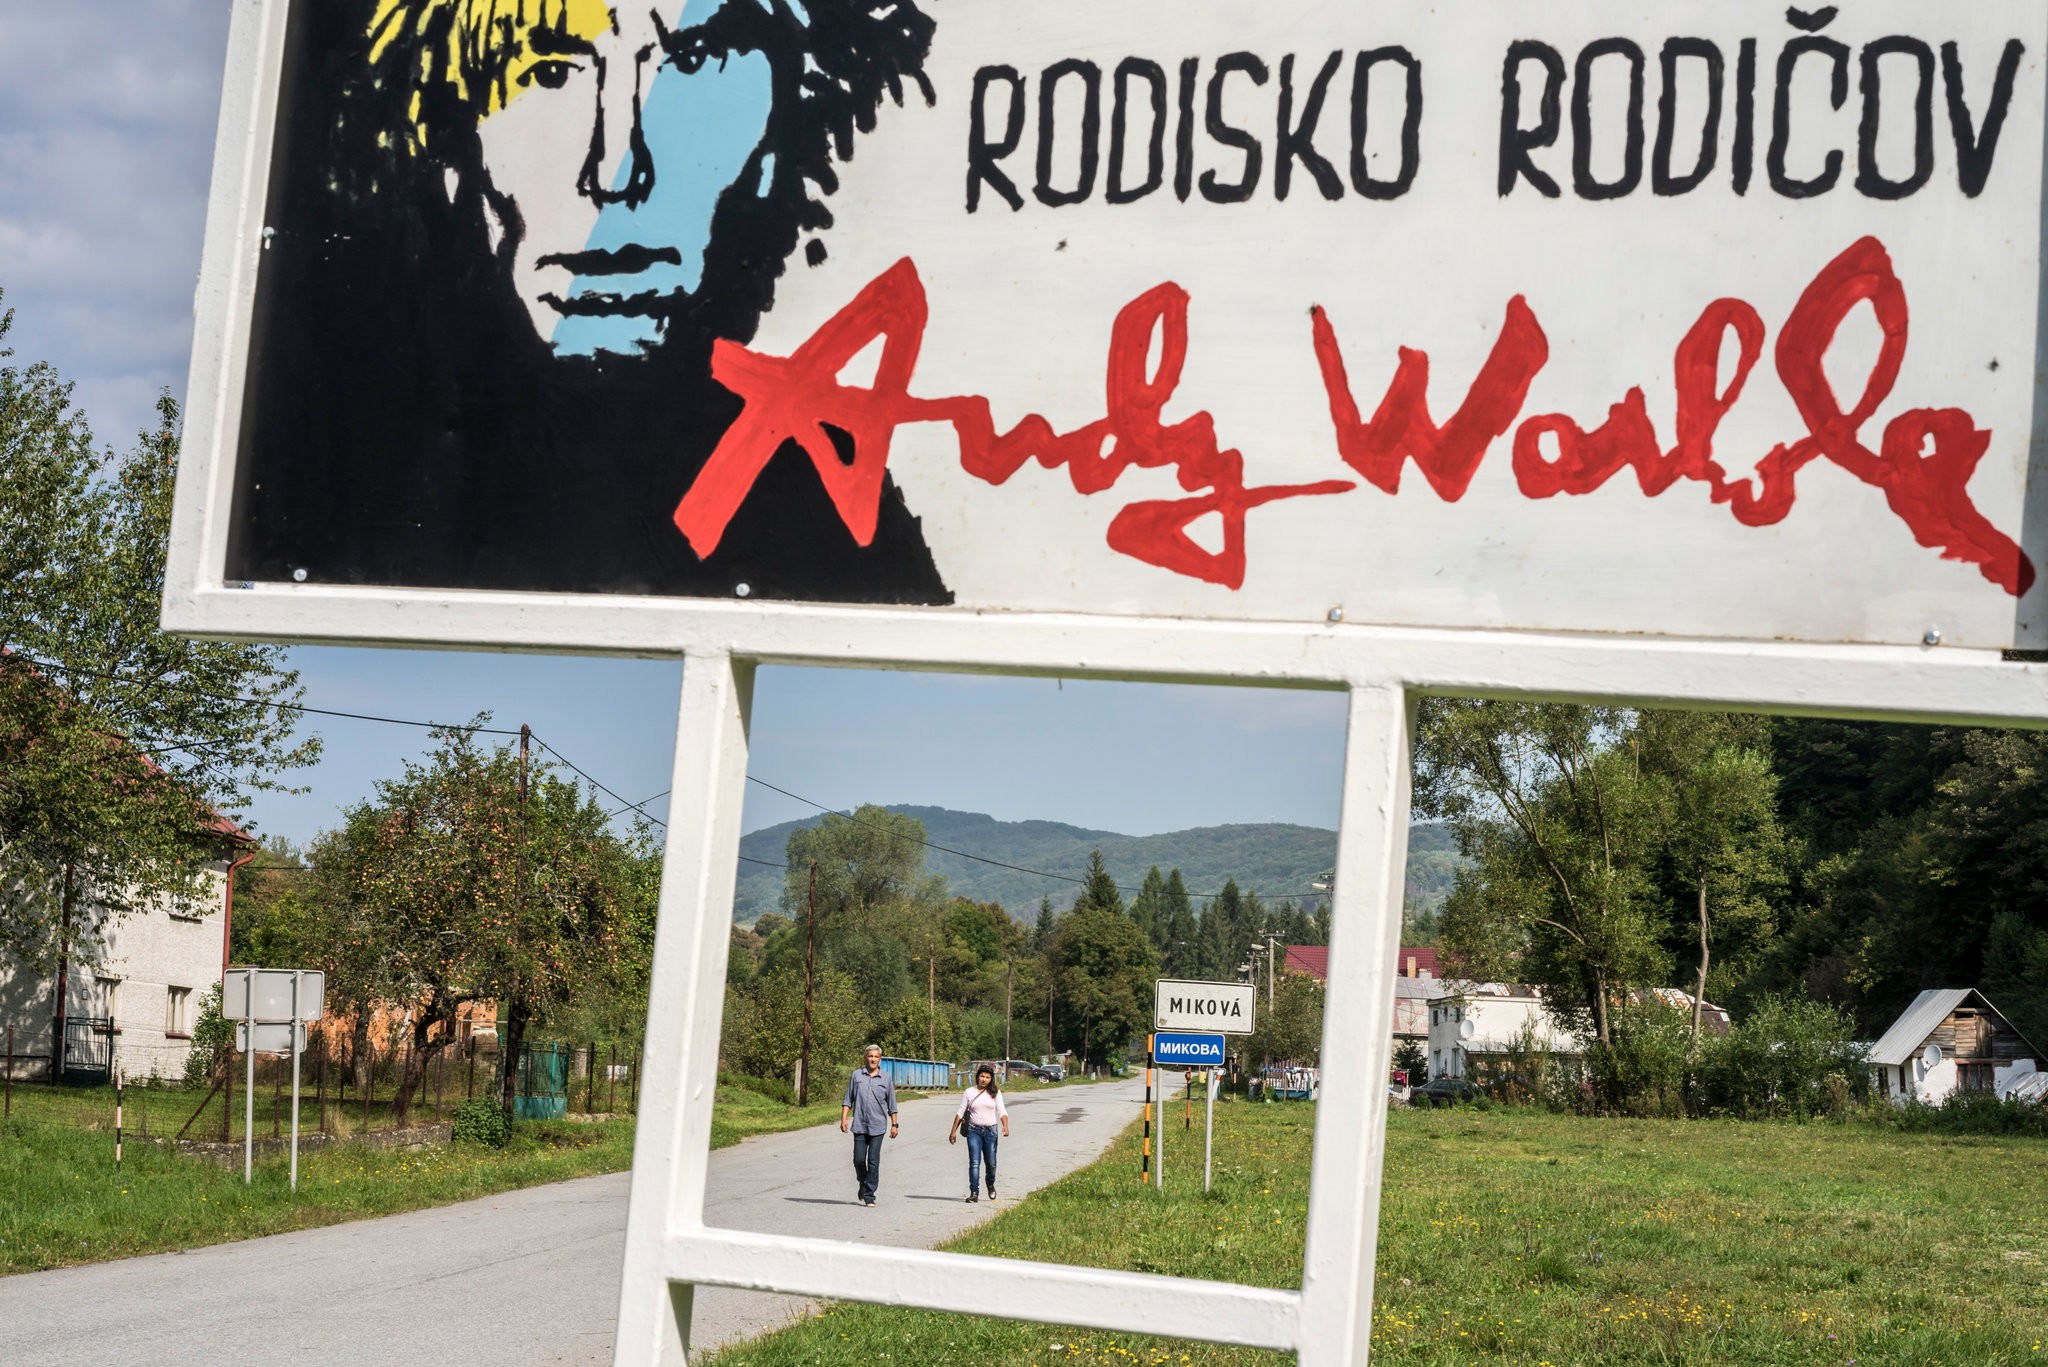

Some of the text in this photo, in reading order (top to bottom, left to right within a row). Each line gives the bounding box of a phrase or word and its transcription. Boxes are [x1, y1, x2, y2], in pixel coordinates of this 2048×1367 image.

[966, 6, 2026, 213] RODISKO RODIČOV
[673, 256, 1356, 591] Andy
[1159, 1042, 1221, 1056] МИКОВА
[1169, 997, 1241, 1017] MIKOVÁ
